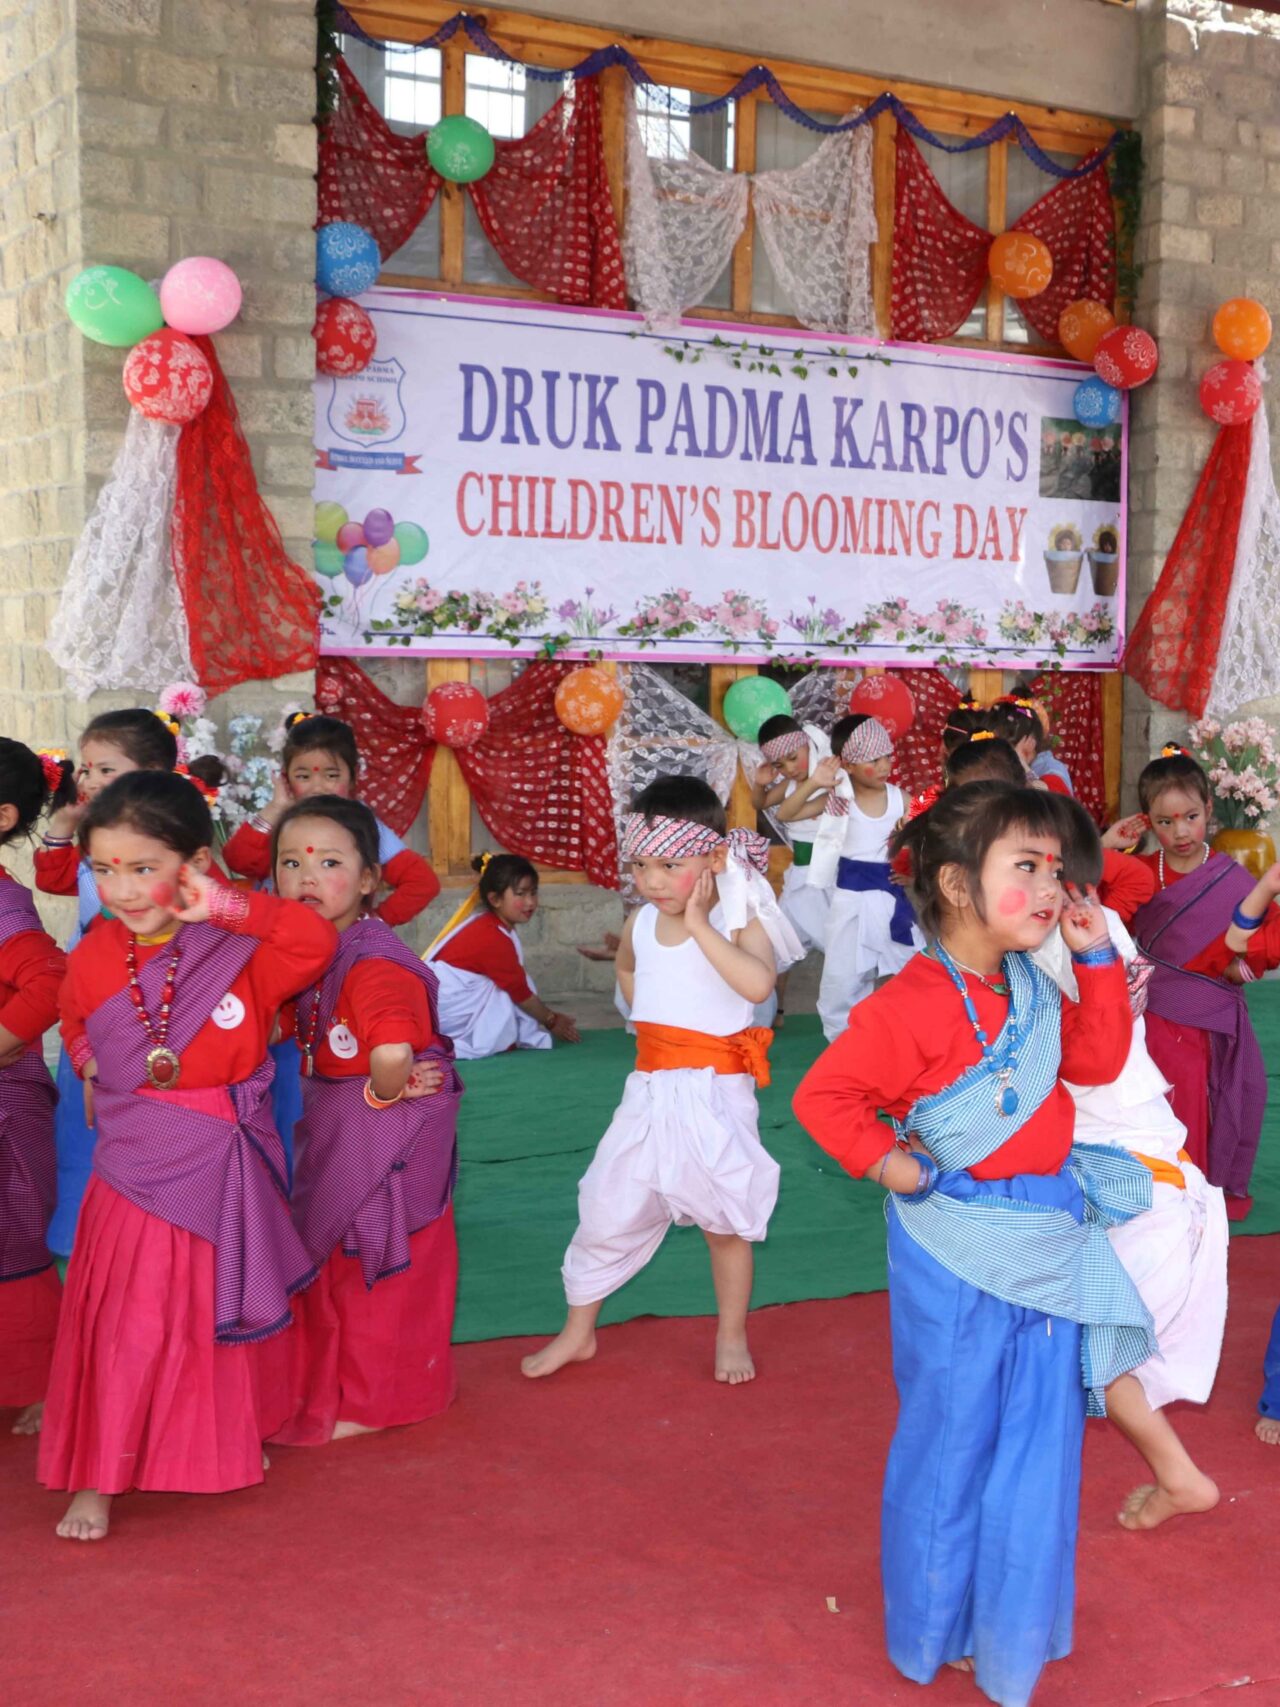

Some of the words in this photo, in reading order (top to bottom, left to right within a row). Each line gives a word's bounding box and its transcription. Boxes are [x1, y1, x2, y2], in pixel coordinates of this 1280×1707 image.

[458, 363, 621, 451] DRUK
[635, 378, 817, 465] PADMA
[830, 396, 1029, 482] KARPO'S
[456, 471, 721, 548] CHILDREN'S
[732, 489, 941, 559] BLOOMING
[953, 503, 1028, 562] DAY
